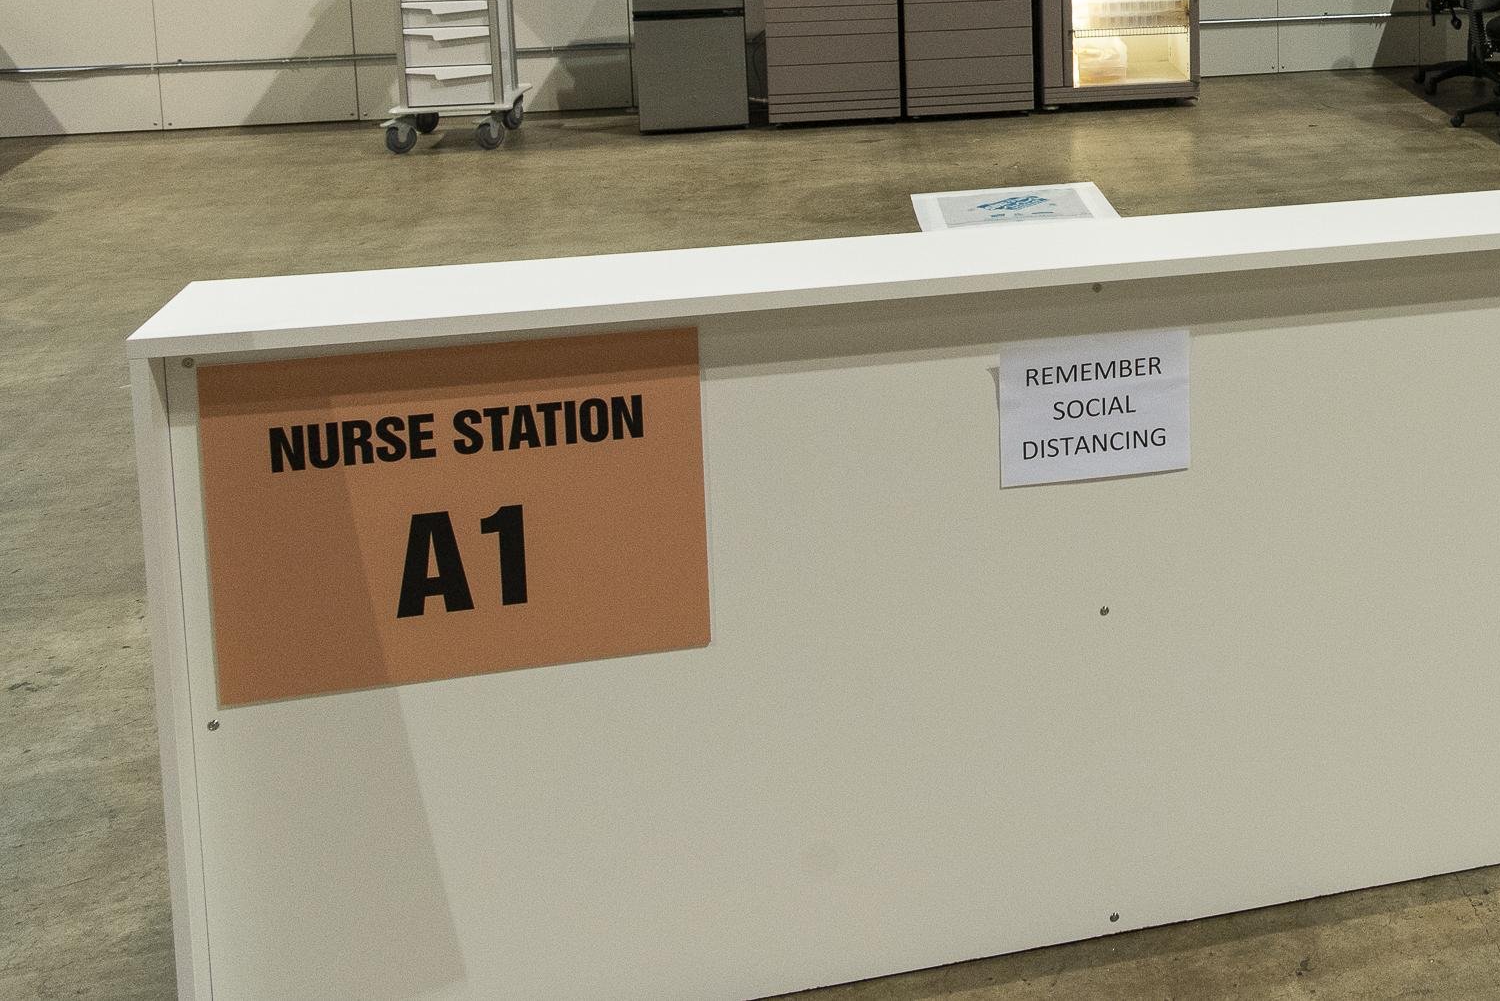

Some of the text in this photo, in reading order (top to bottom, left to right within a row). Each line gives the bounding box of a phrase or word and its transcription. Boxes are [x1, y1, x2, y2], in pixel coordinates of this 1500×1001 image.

[1025, 356, 1162, 387] REMEMBER
[1052, 395, 1137, 421] SOCIAL
[268, 393, 644, 474] NURSE STATION
[1022, 427, 1167, 460] DISTANCING
[396, 503, 529, 619] A1
